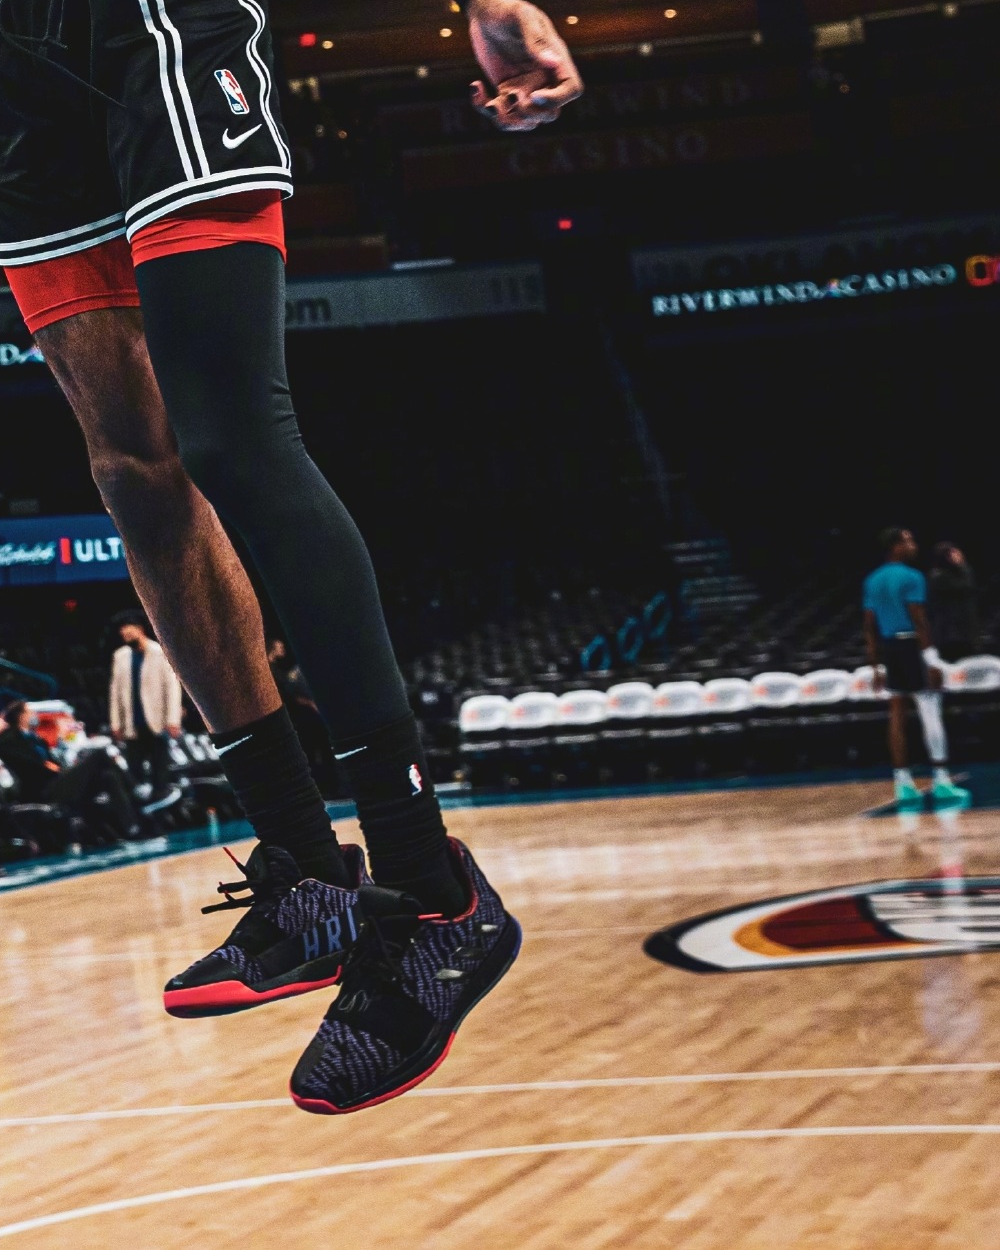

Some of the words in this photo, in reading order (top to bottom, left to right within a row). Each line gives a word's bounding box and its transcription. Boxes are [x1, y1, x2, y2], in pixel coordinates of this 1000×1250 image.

[651, 280, 824, 317] RIVERWIND
[842, 263, 958, 298] CASINO
[73, 536, 127, 562] ULT
